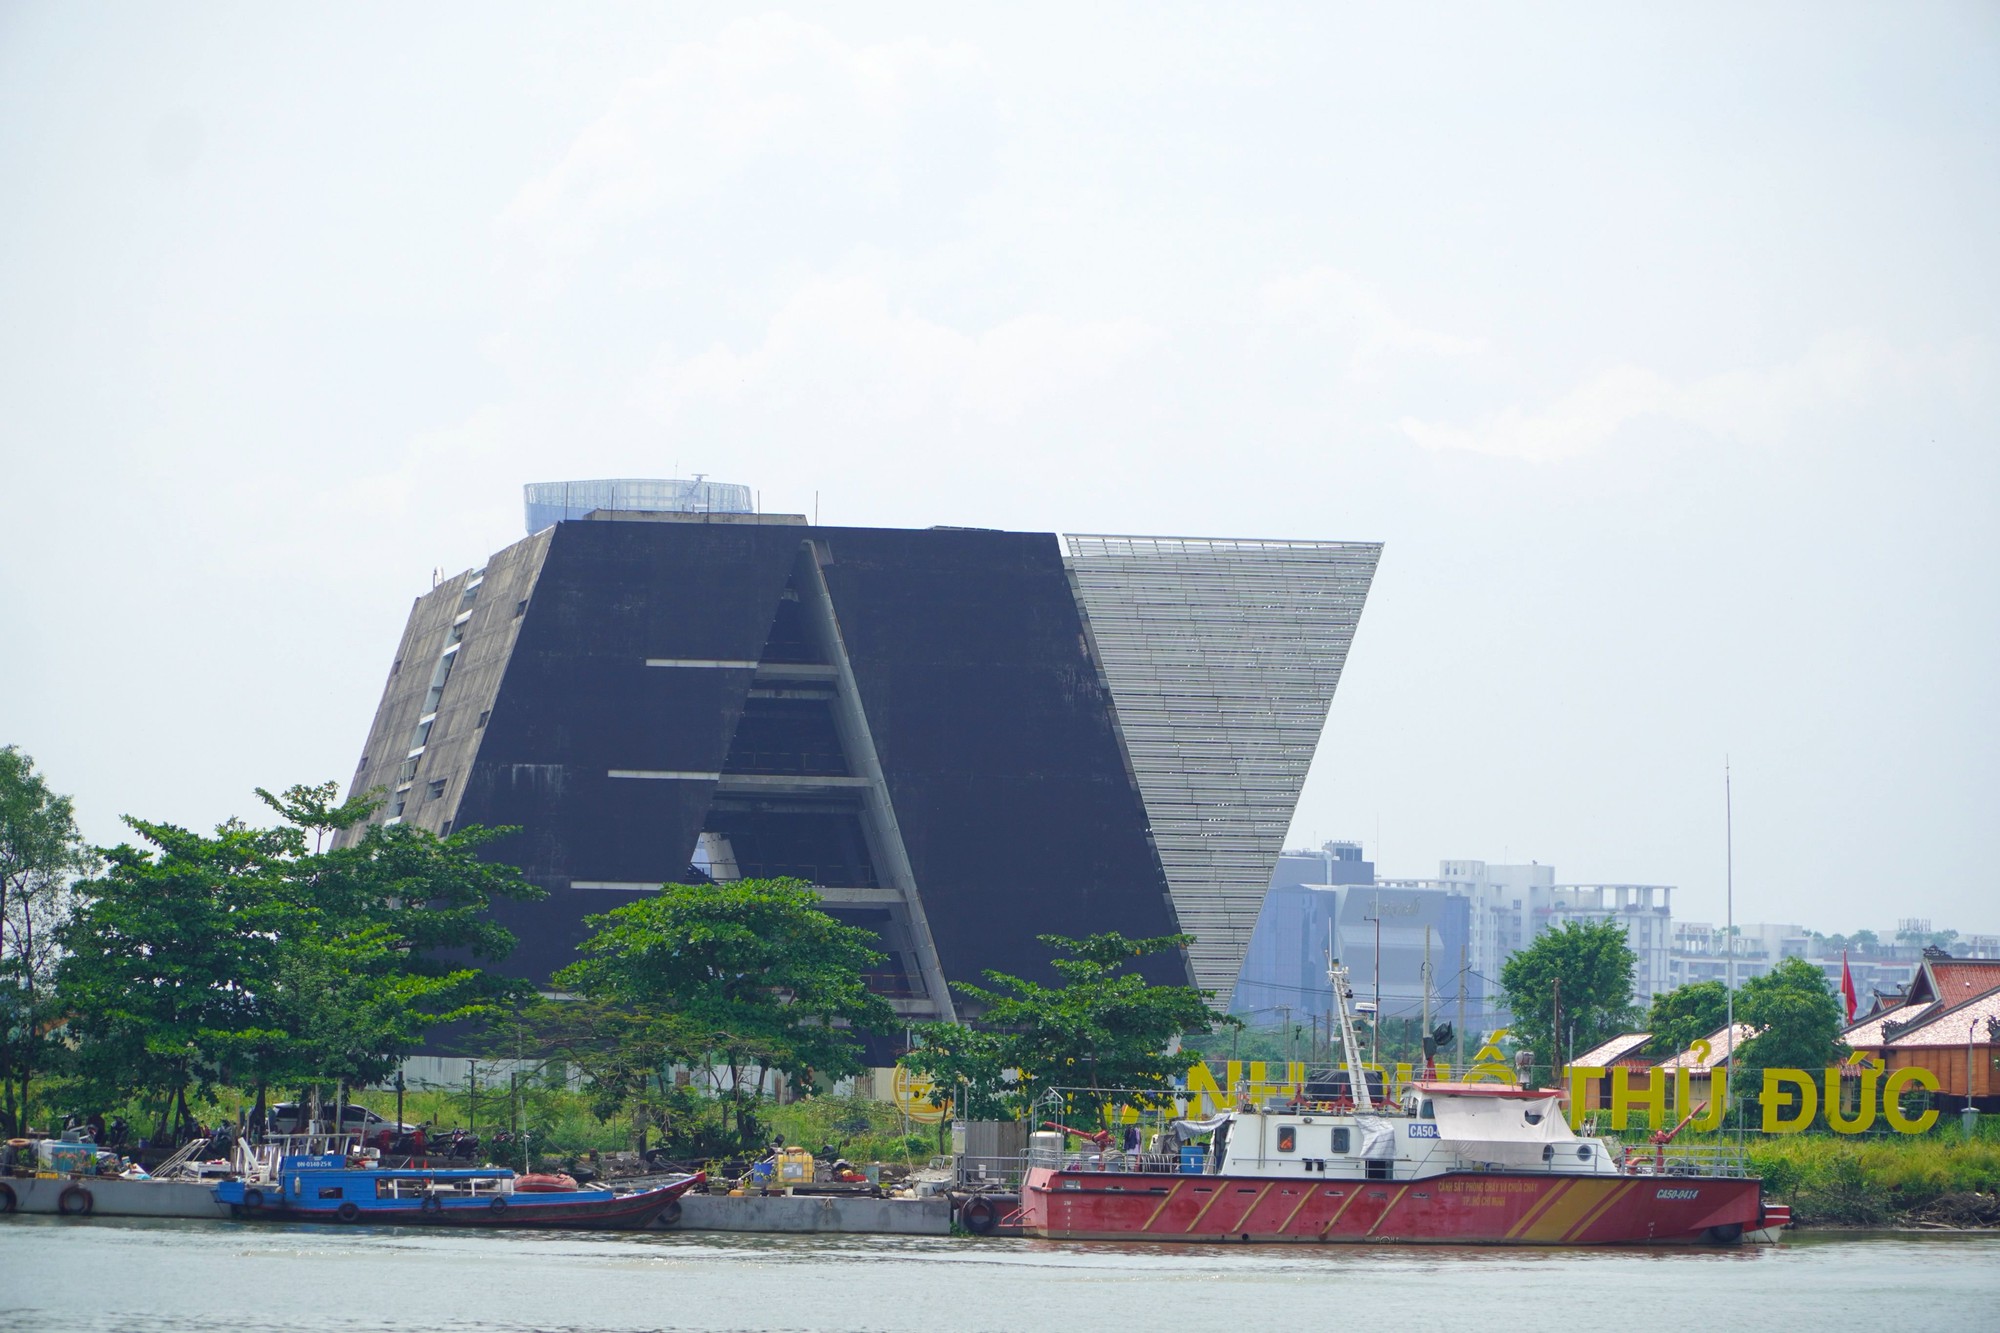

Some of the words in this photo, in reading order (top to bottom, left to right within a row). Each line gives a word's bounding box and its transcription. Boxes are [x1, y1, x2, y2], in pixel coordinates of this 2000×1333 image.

[1563, 1039, 1728, 1132] THỦ
[1758, 1050, 1941, 1135] ĐỨC
[1656, 1189, 1699, 1199] CA50-0414
